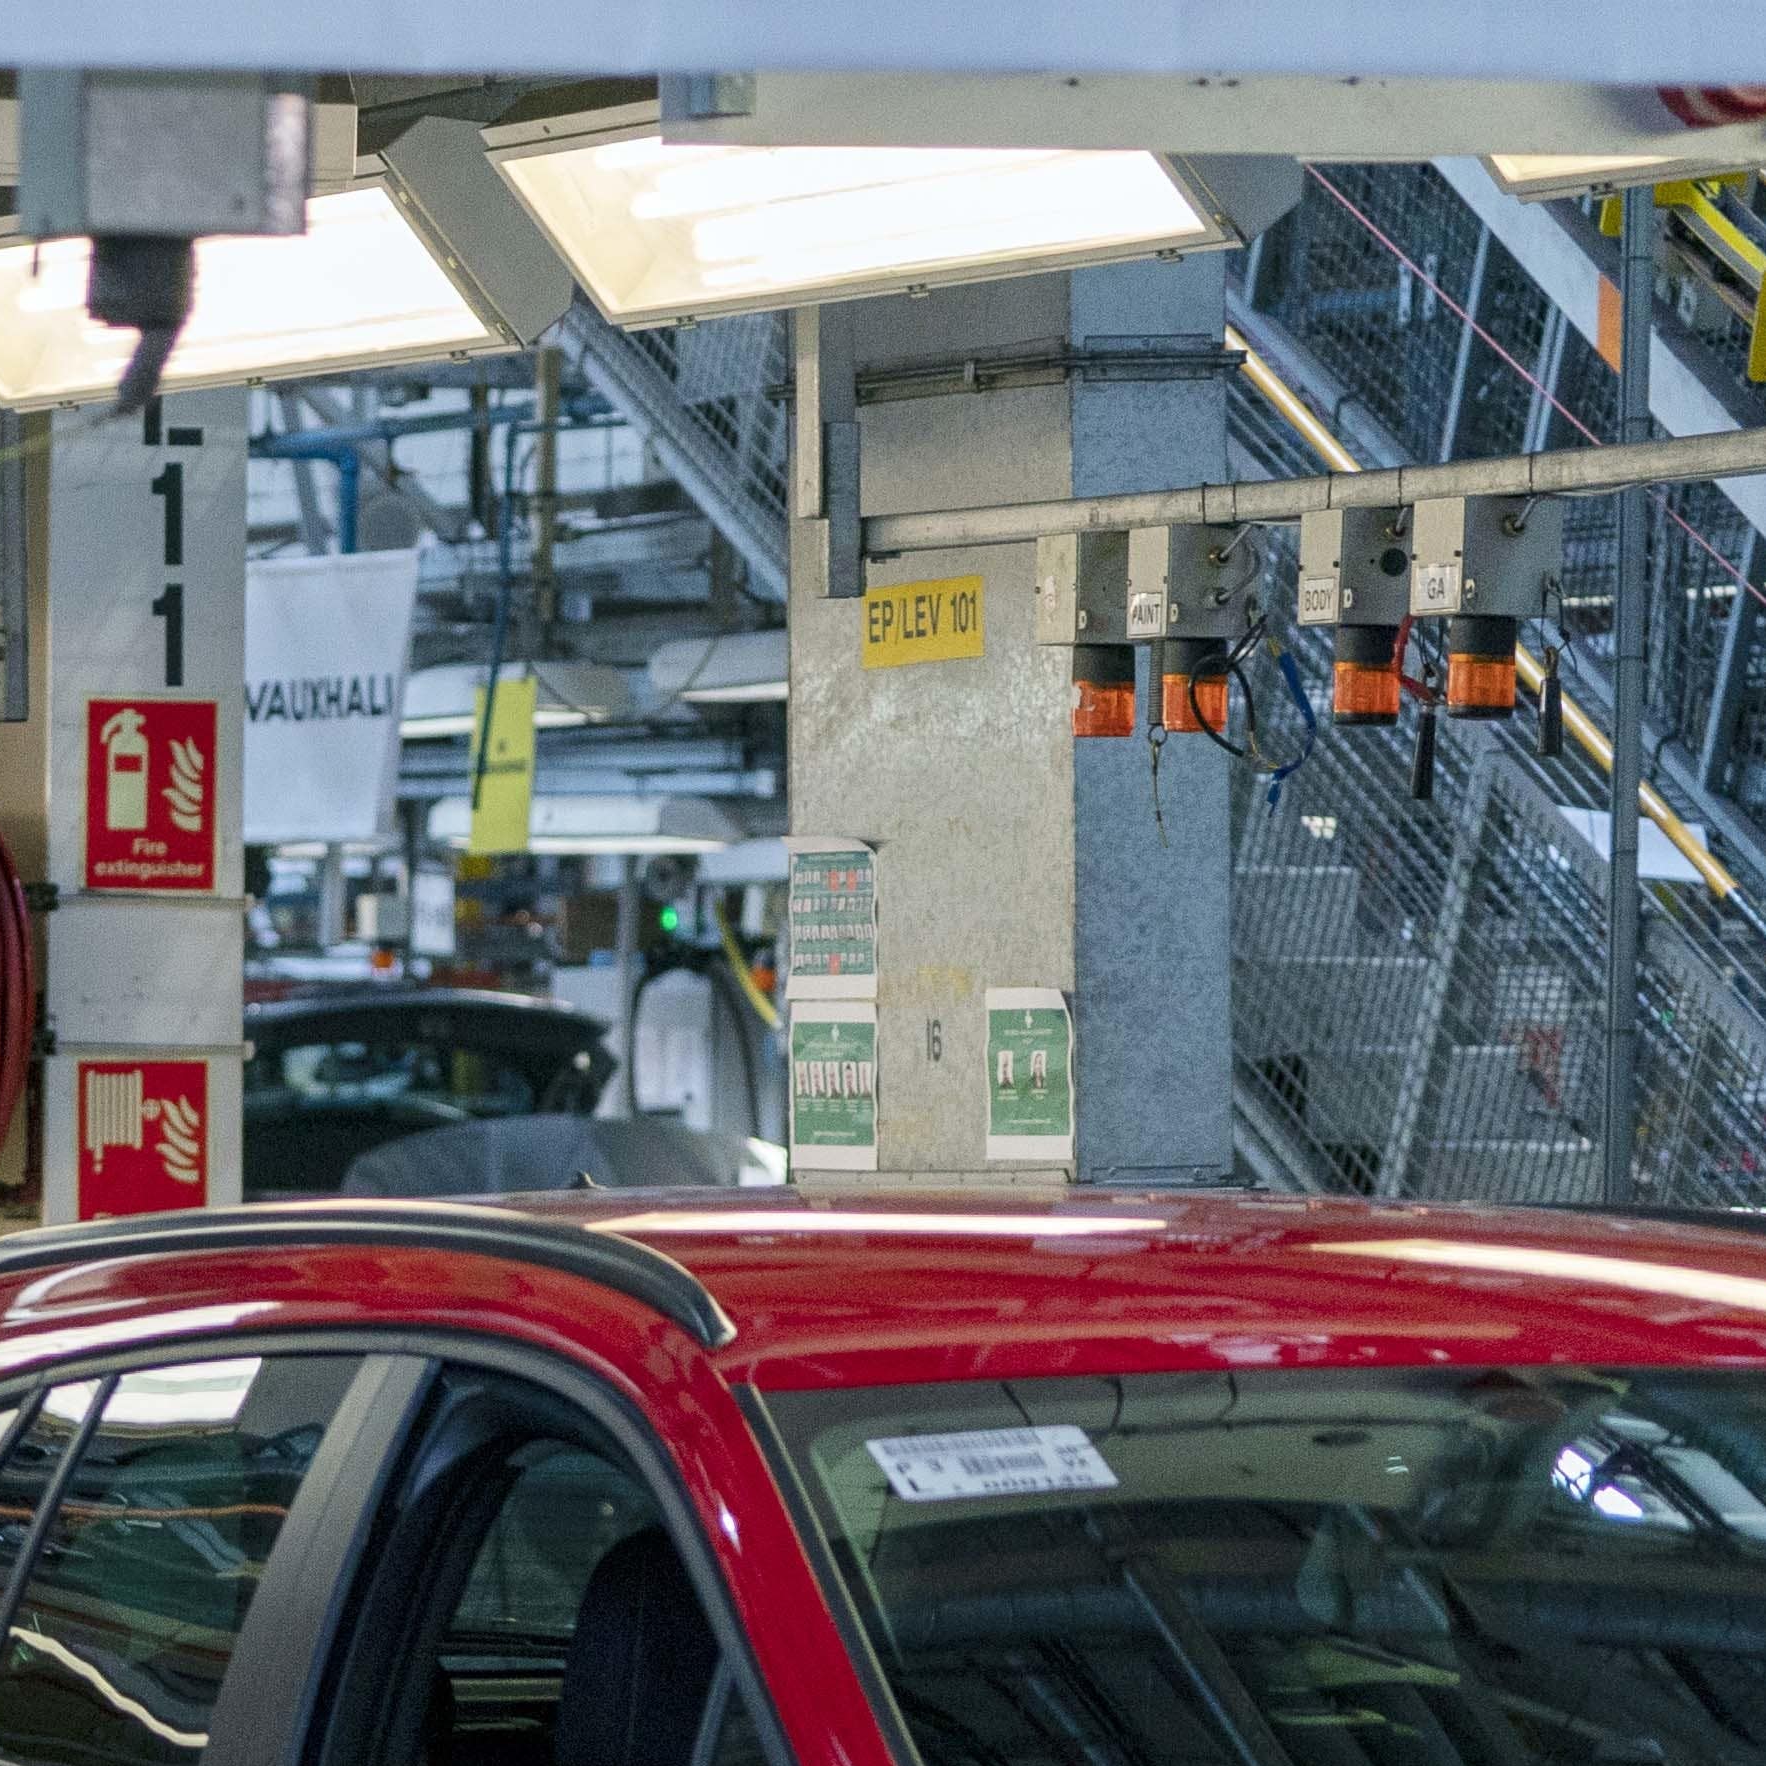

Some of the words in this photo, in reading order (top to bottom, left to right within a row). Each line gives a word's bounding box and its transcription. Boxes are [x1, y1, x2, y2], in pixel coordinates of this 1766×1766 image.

[1427, 577, 1446, 600] GA
[1304, 590, 1333, 612] BODY
[868, 592, 943, 646] EP/LEV
[951, 589, 977, 634] 101
[1131, 602, 1160, 625] PAINT
[130, 837, 168, 857] Fire
[93, 859, 205, 881] extinguisher
